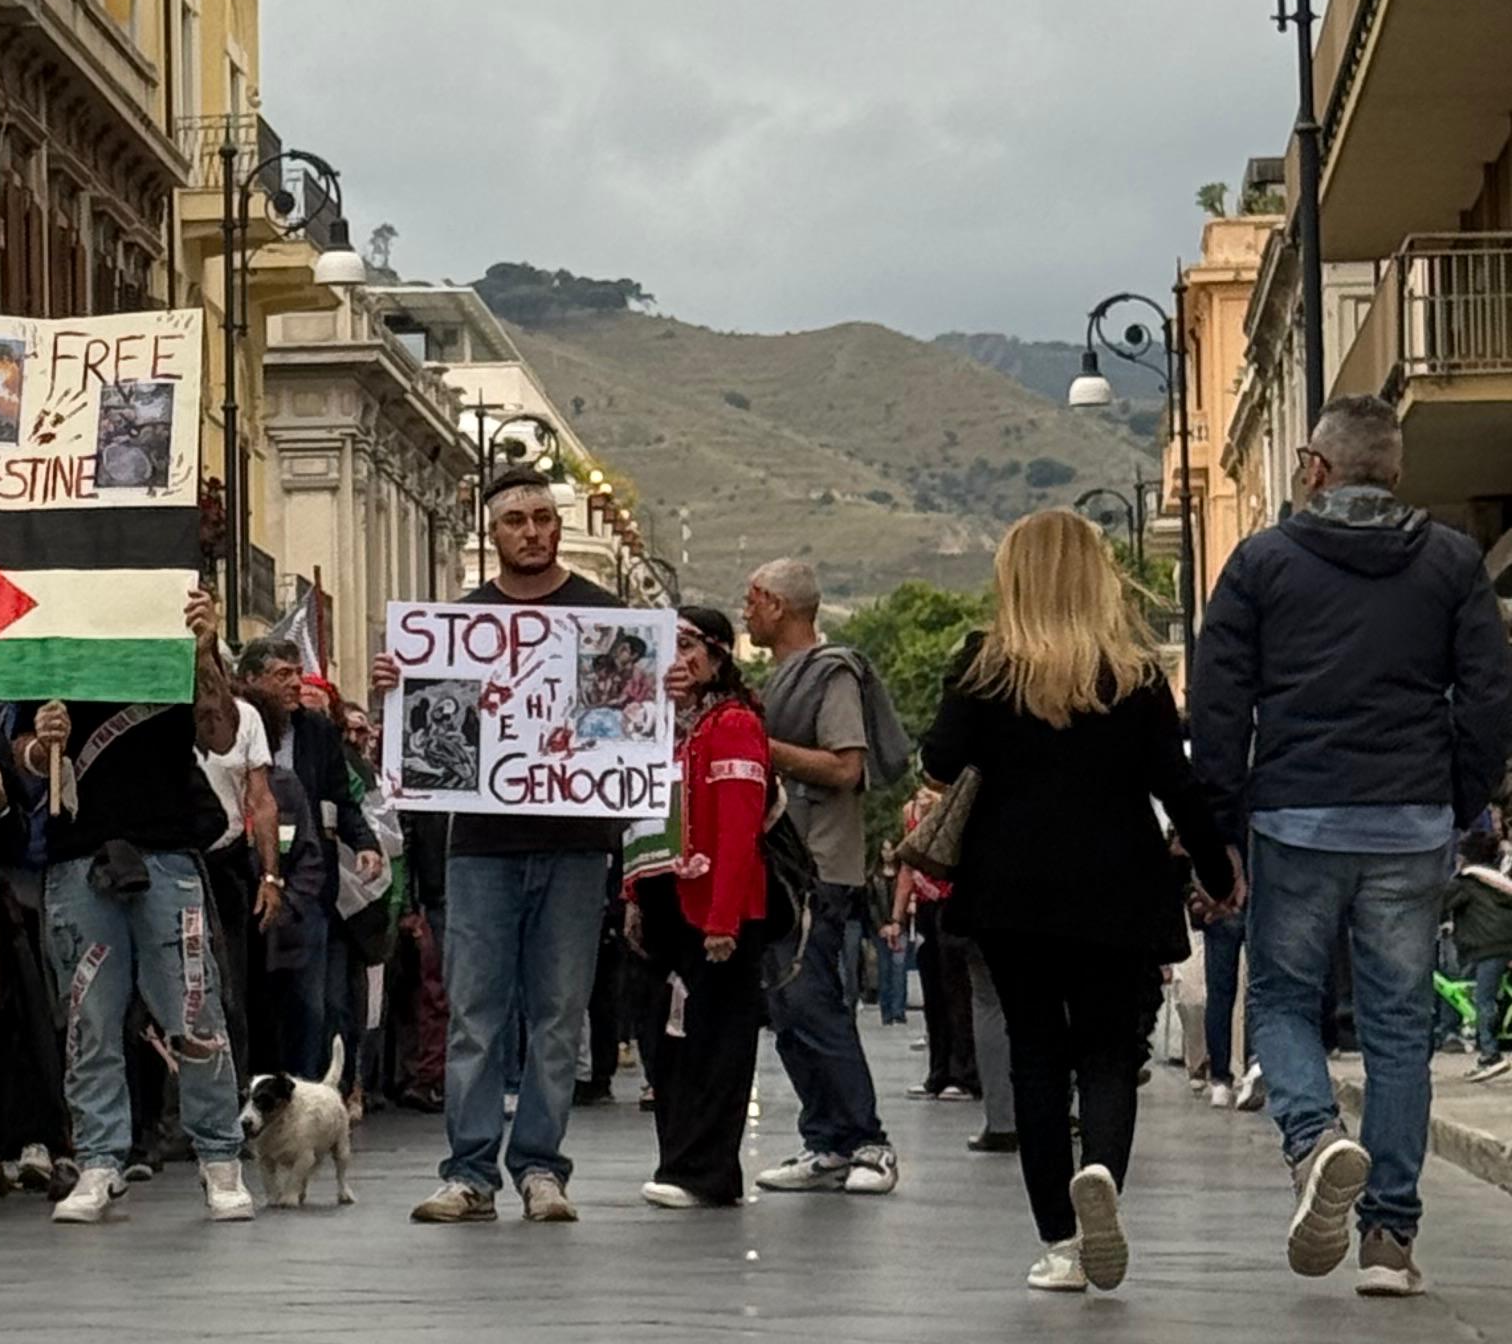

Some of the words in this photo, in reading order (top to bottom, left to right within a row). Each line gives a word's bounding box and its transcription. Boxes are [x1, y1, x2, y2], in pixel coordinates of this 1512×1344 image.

[47, 331, 186, 400] FREE
[395, 610, 551, 677] STOP
[489, 752, 668, 810] GENOCIDE
